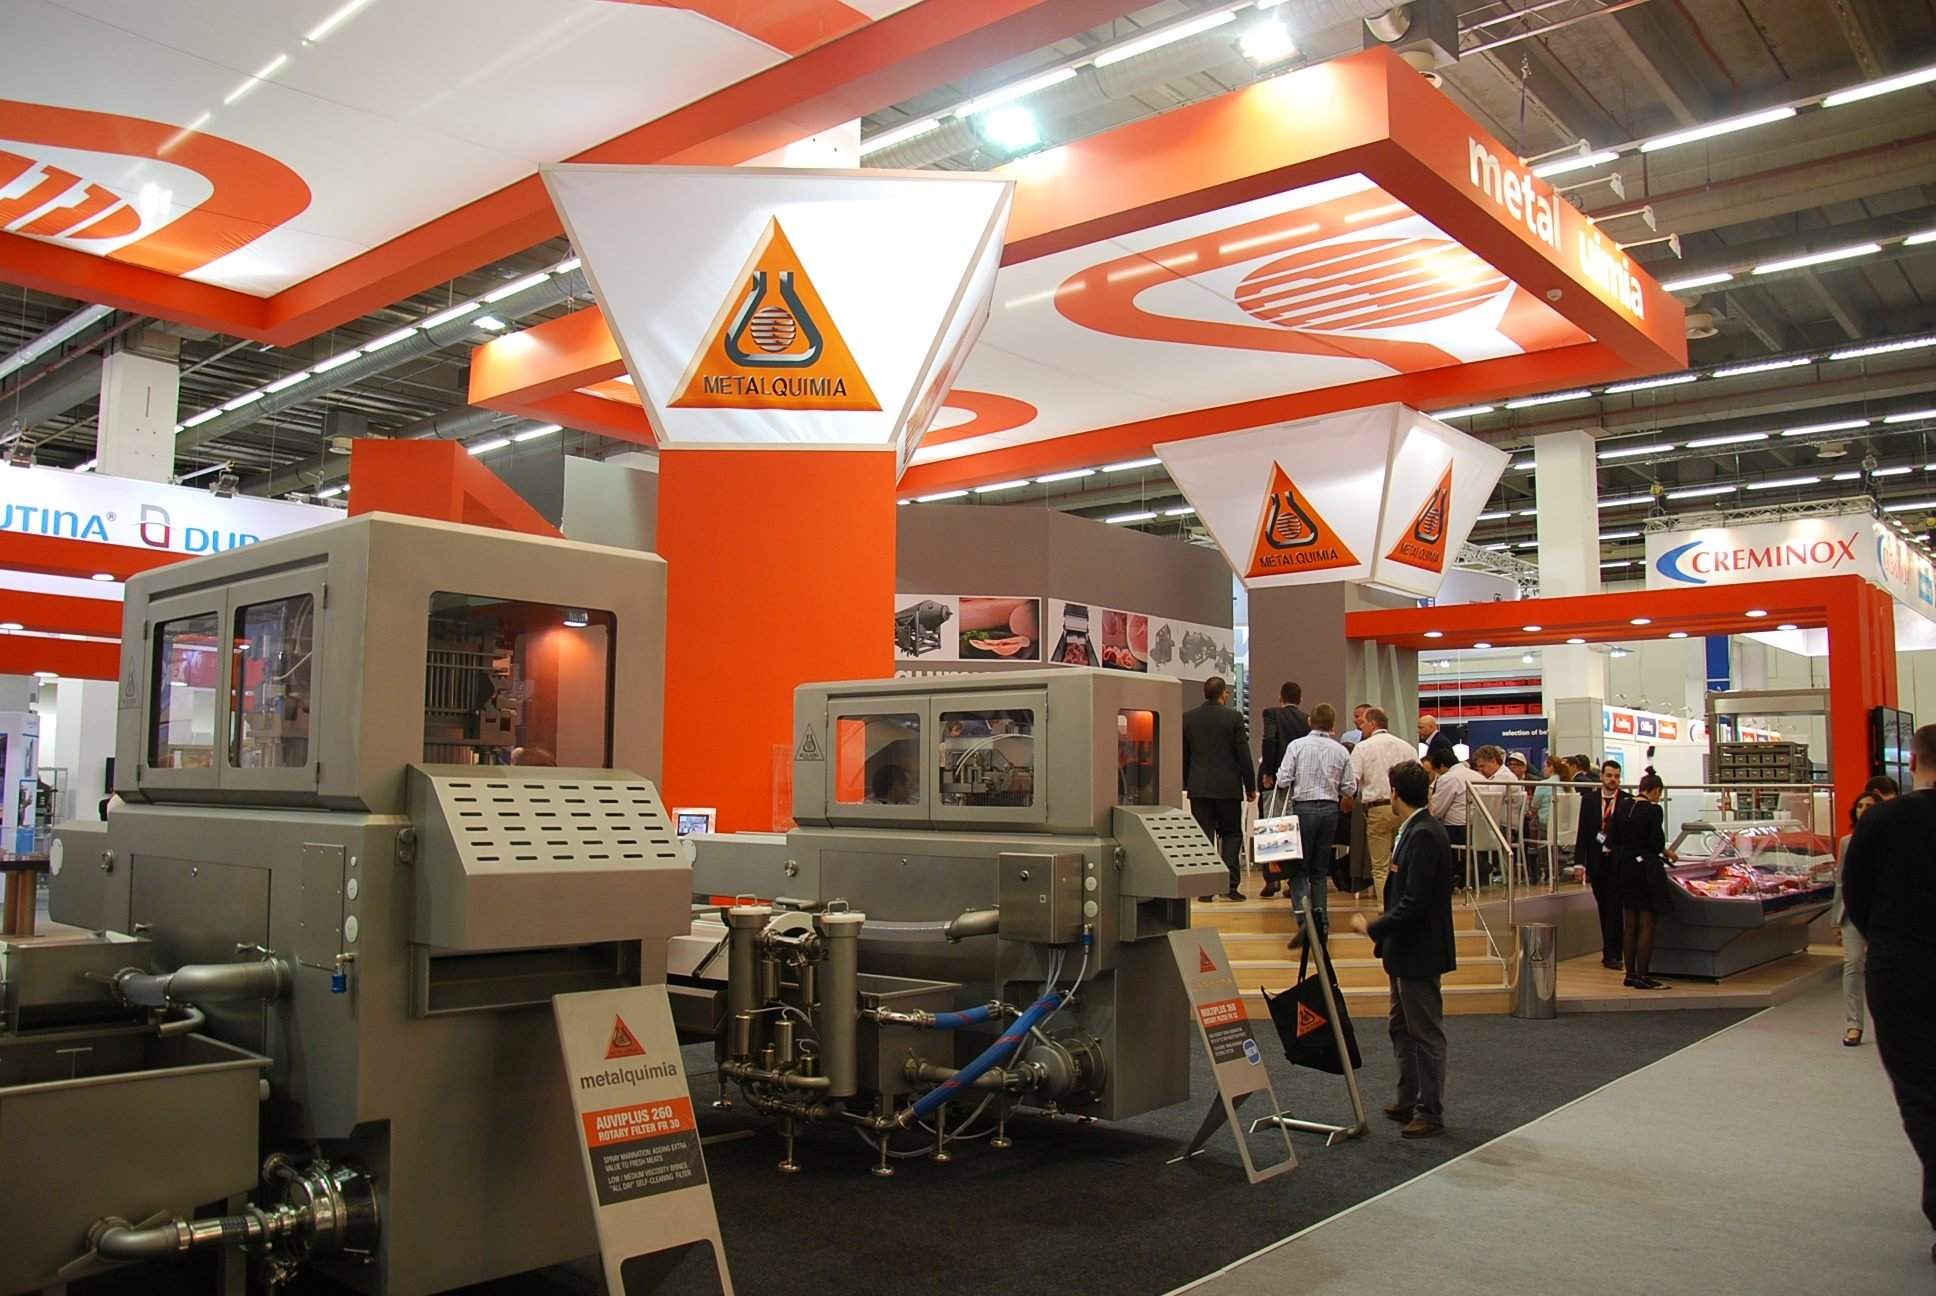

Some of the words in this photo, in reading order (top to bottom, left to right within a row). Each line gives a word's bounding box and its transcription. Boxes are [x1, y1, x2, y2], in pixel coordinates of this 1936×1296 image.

[704, 376, 847, 397] METALQUIMIA
[1260, 548, 1338, 568] METALQUIMIA
[1692, 532, 1859, 574] CREMINOX
[580, 1061, 677, 1089] metalquimia
[596, 1109, 649, 1130] AUVIPLUS
[652, 1105, 672, 1121] 260
[598, 1127, 629, 1141] ROTARY
[631, 1122, 656, 1136] FILTER
